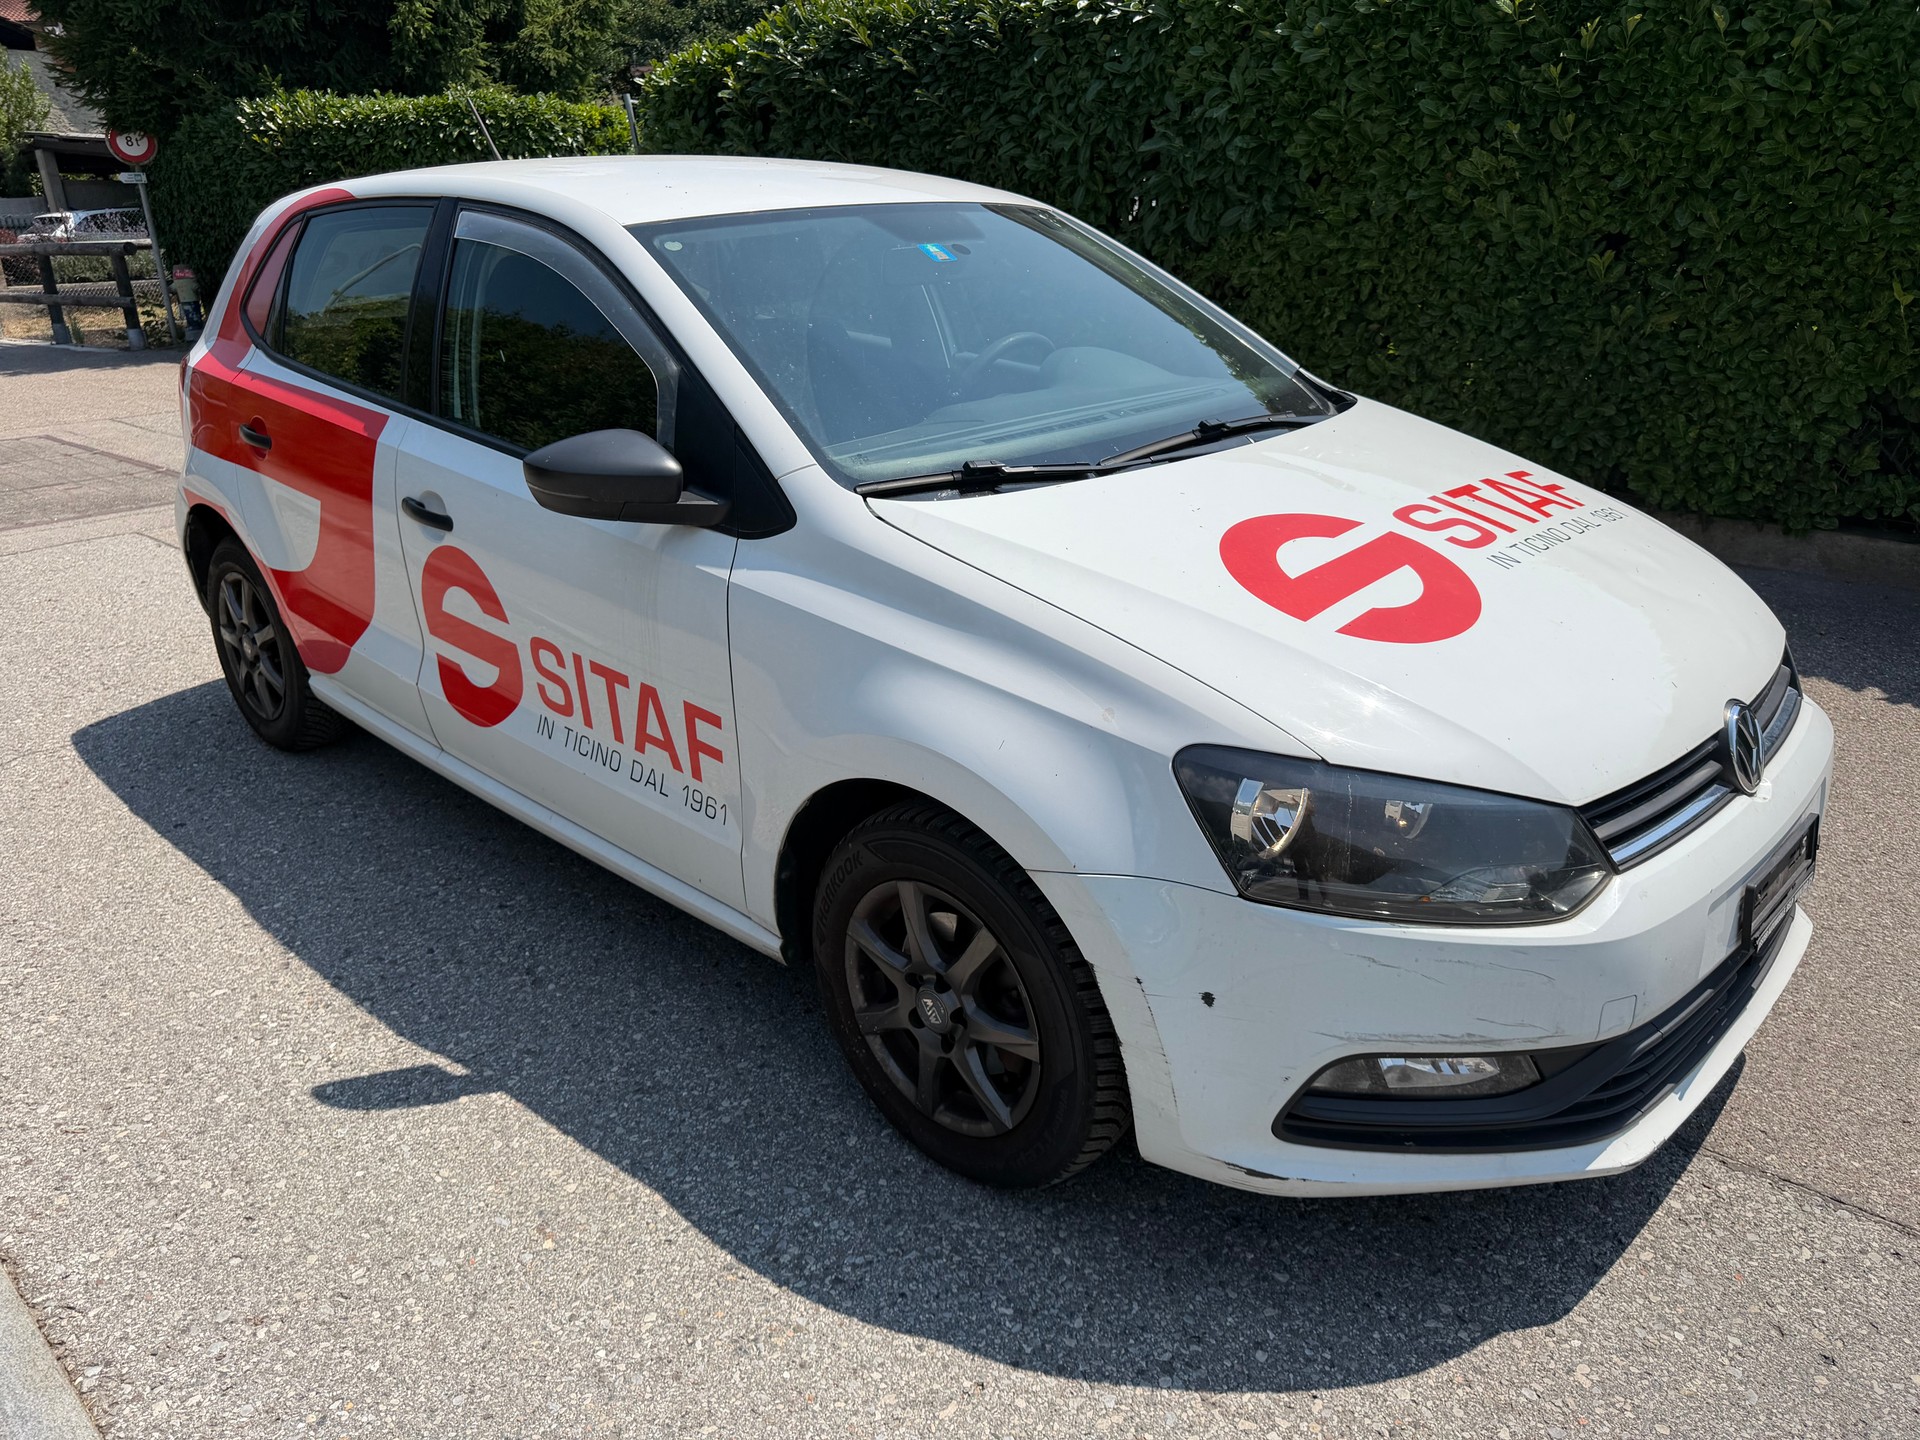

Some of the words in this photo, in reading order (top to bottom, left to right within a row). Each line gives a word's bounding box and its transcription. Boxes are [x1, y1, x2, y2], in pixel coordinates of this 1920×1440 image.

[1392, 470, 1585, 550] SITAF
[1486, 551, 1522, 570] IN
[1508, 527, 1572, 557] TICINO
[1560, 516, 1602, 535] DAL
[1590, 506, 1630, 523] 1961
[529, 636, 724, 783] SITAF
[536, 713, 555, 740] IN
[564, 726, 622, 773] TICINO
[629, 759, 669, 797] DAL
[682, 785, 728, 826] 1961
